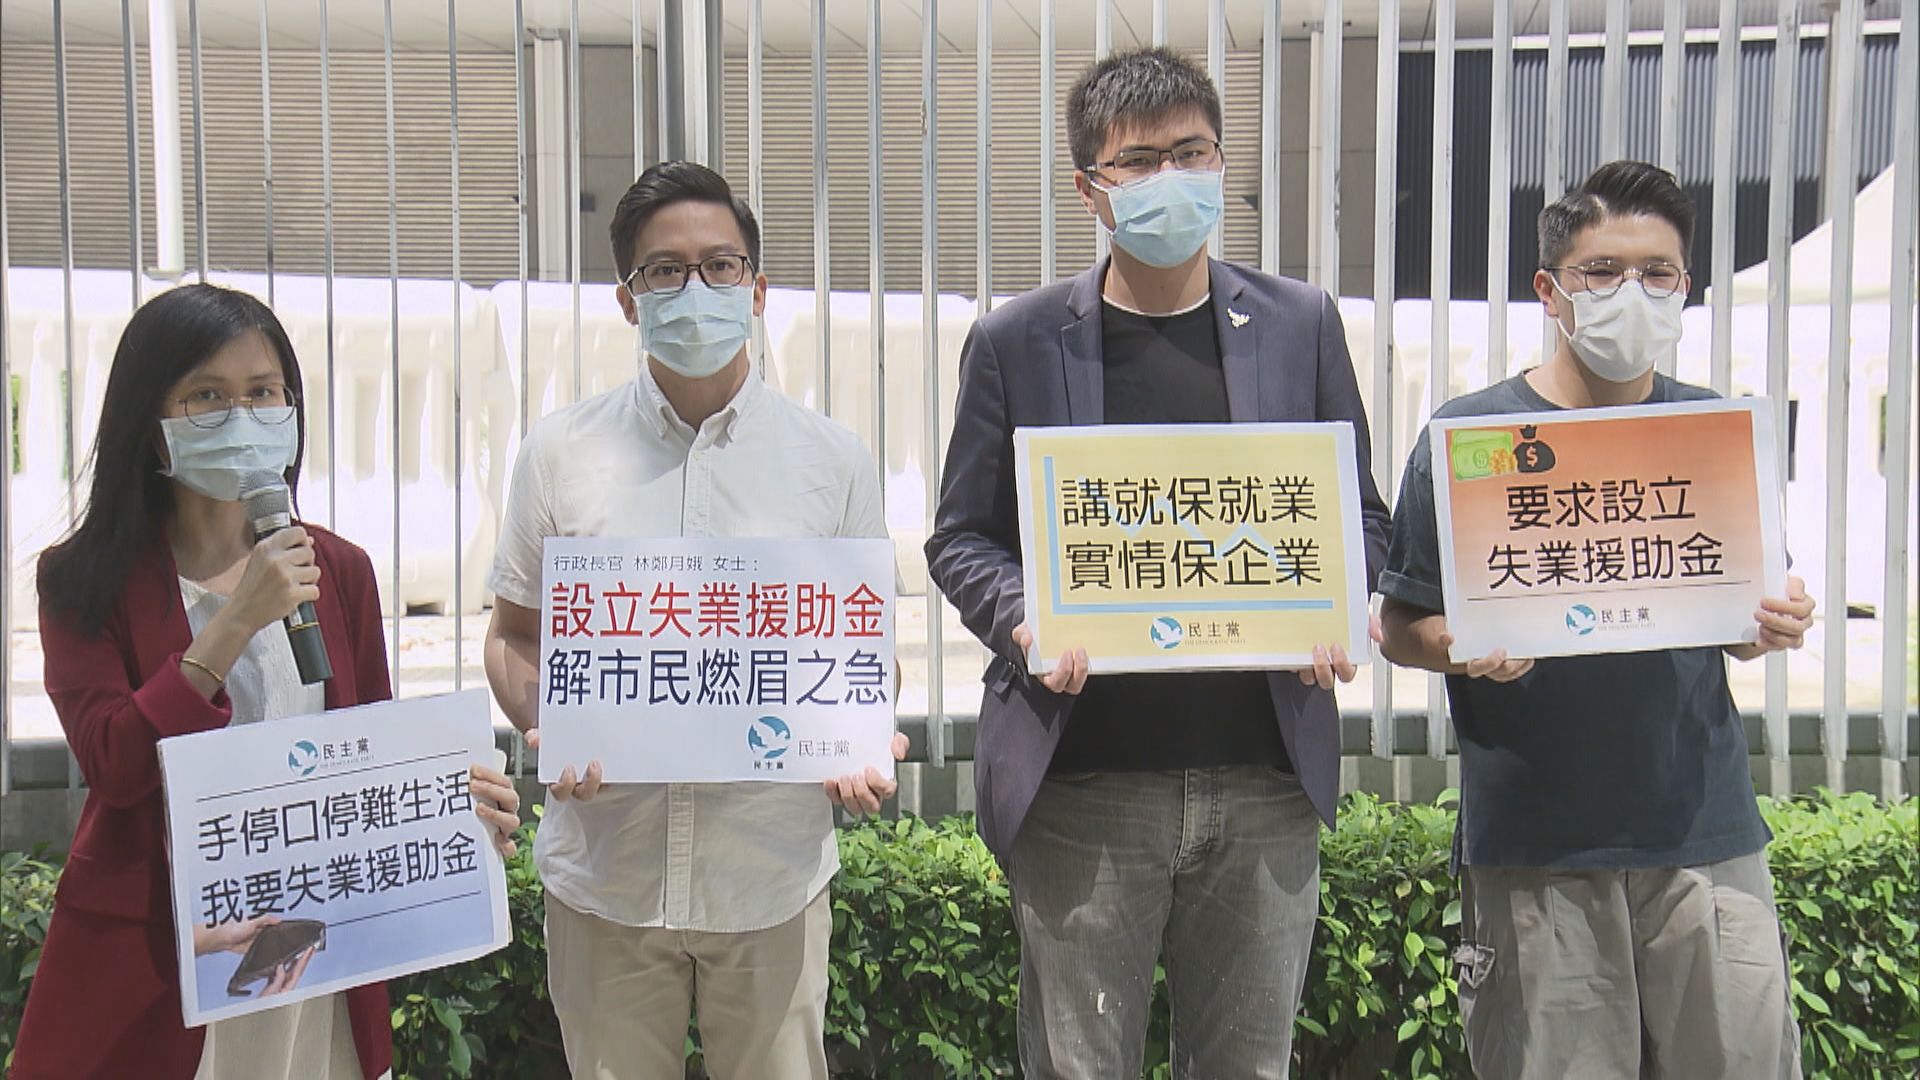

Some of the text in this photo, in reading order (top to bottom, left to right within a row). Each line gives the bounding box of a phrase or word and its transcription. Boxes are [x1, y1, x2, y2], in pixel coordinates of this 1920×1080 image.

[1061, 475, 1318, 528] 講就保就業
[1506, 475, 1696, 531] 要求設立
[553, 555, 624, 572] 行政長官
[633, 555, 703, 572] 林鄭月娥
[1065, 537, 1323, 591] 實情保企業
[1487, 531, 1724, 590] 失業援助金
[551, 580, 885, 640] 設立失業援助金
[546, 647, 888, 706] 解市民燃眉之急
[198, 769, 473, 862] 手停口停難生活
[201, 830, 478, 929] 我要失業援助金
